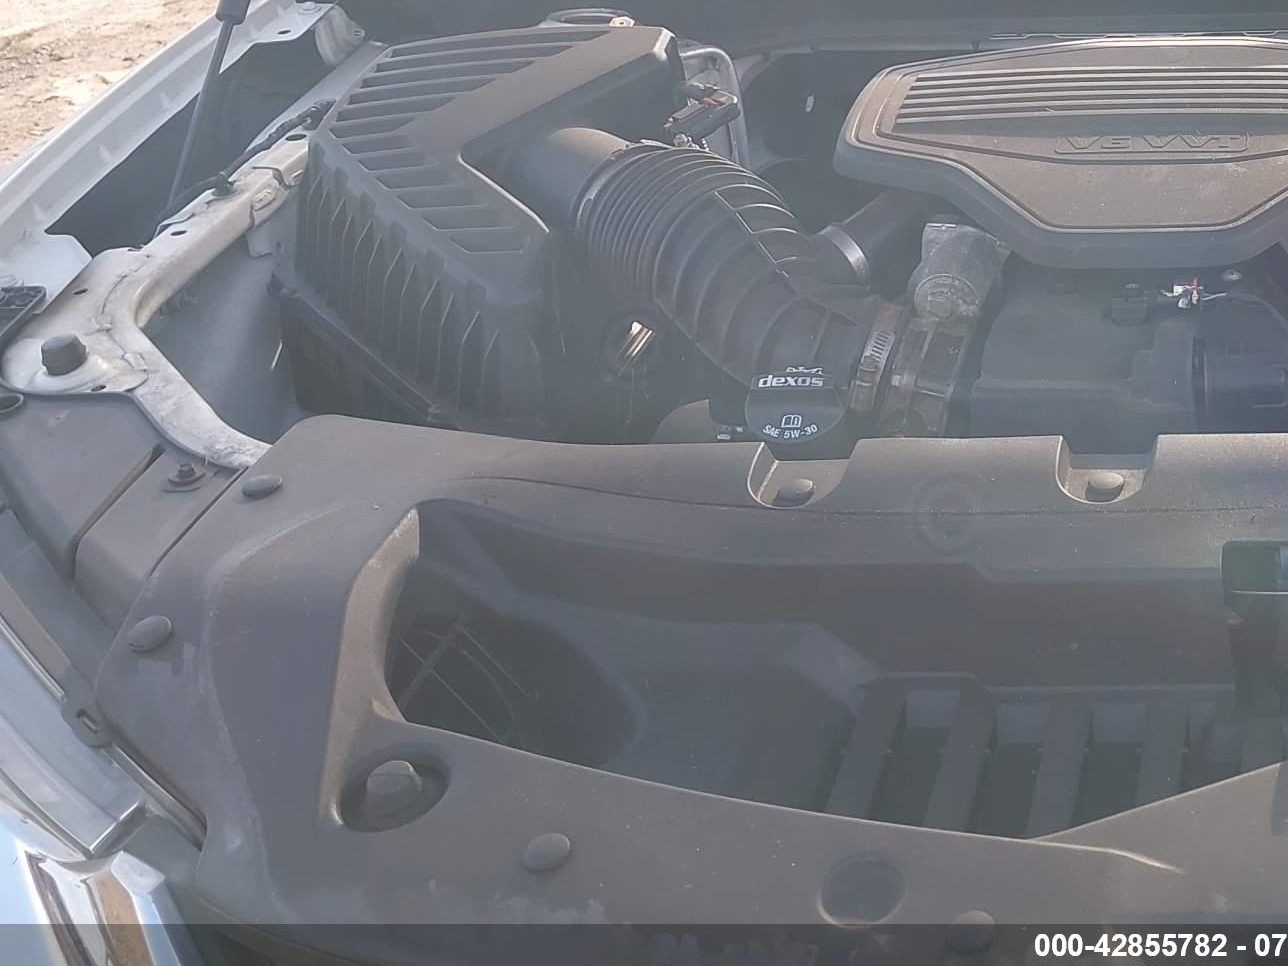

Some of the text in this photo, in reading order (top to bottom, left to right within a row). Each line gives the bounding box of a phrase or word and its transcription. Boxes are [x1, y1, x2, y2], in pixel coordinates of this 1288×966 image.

[758, 374, 825, 388] dexos
[762, 424, 818, 439] SAE 5W-30
